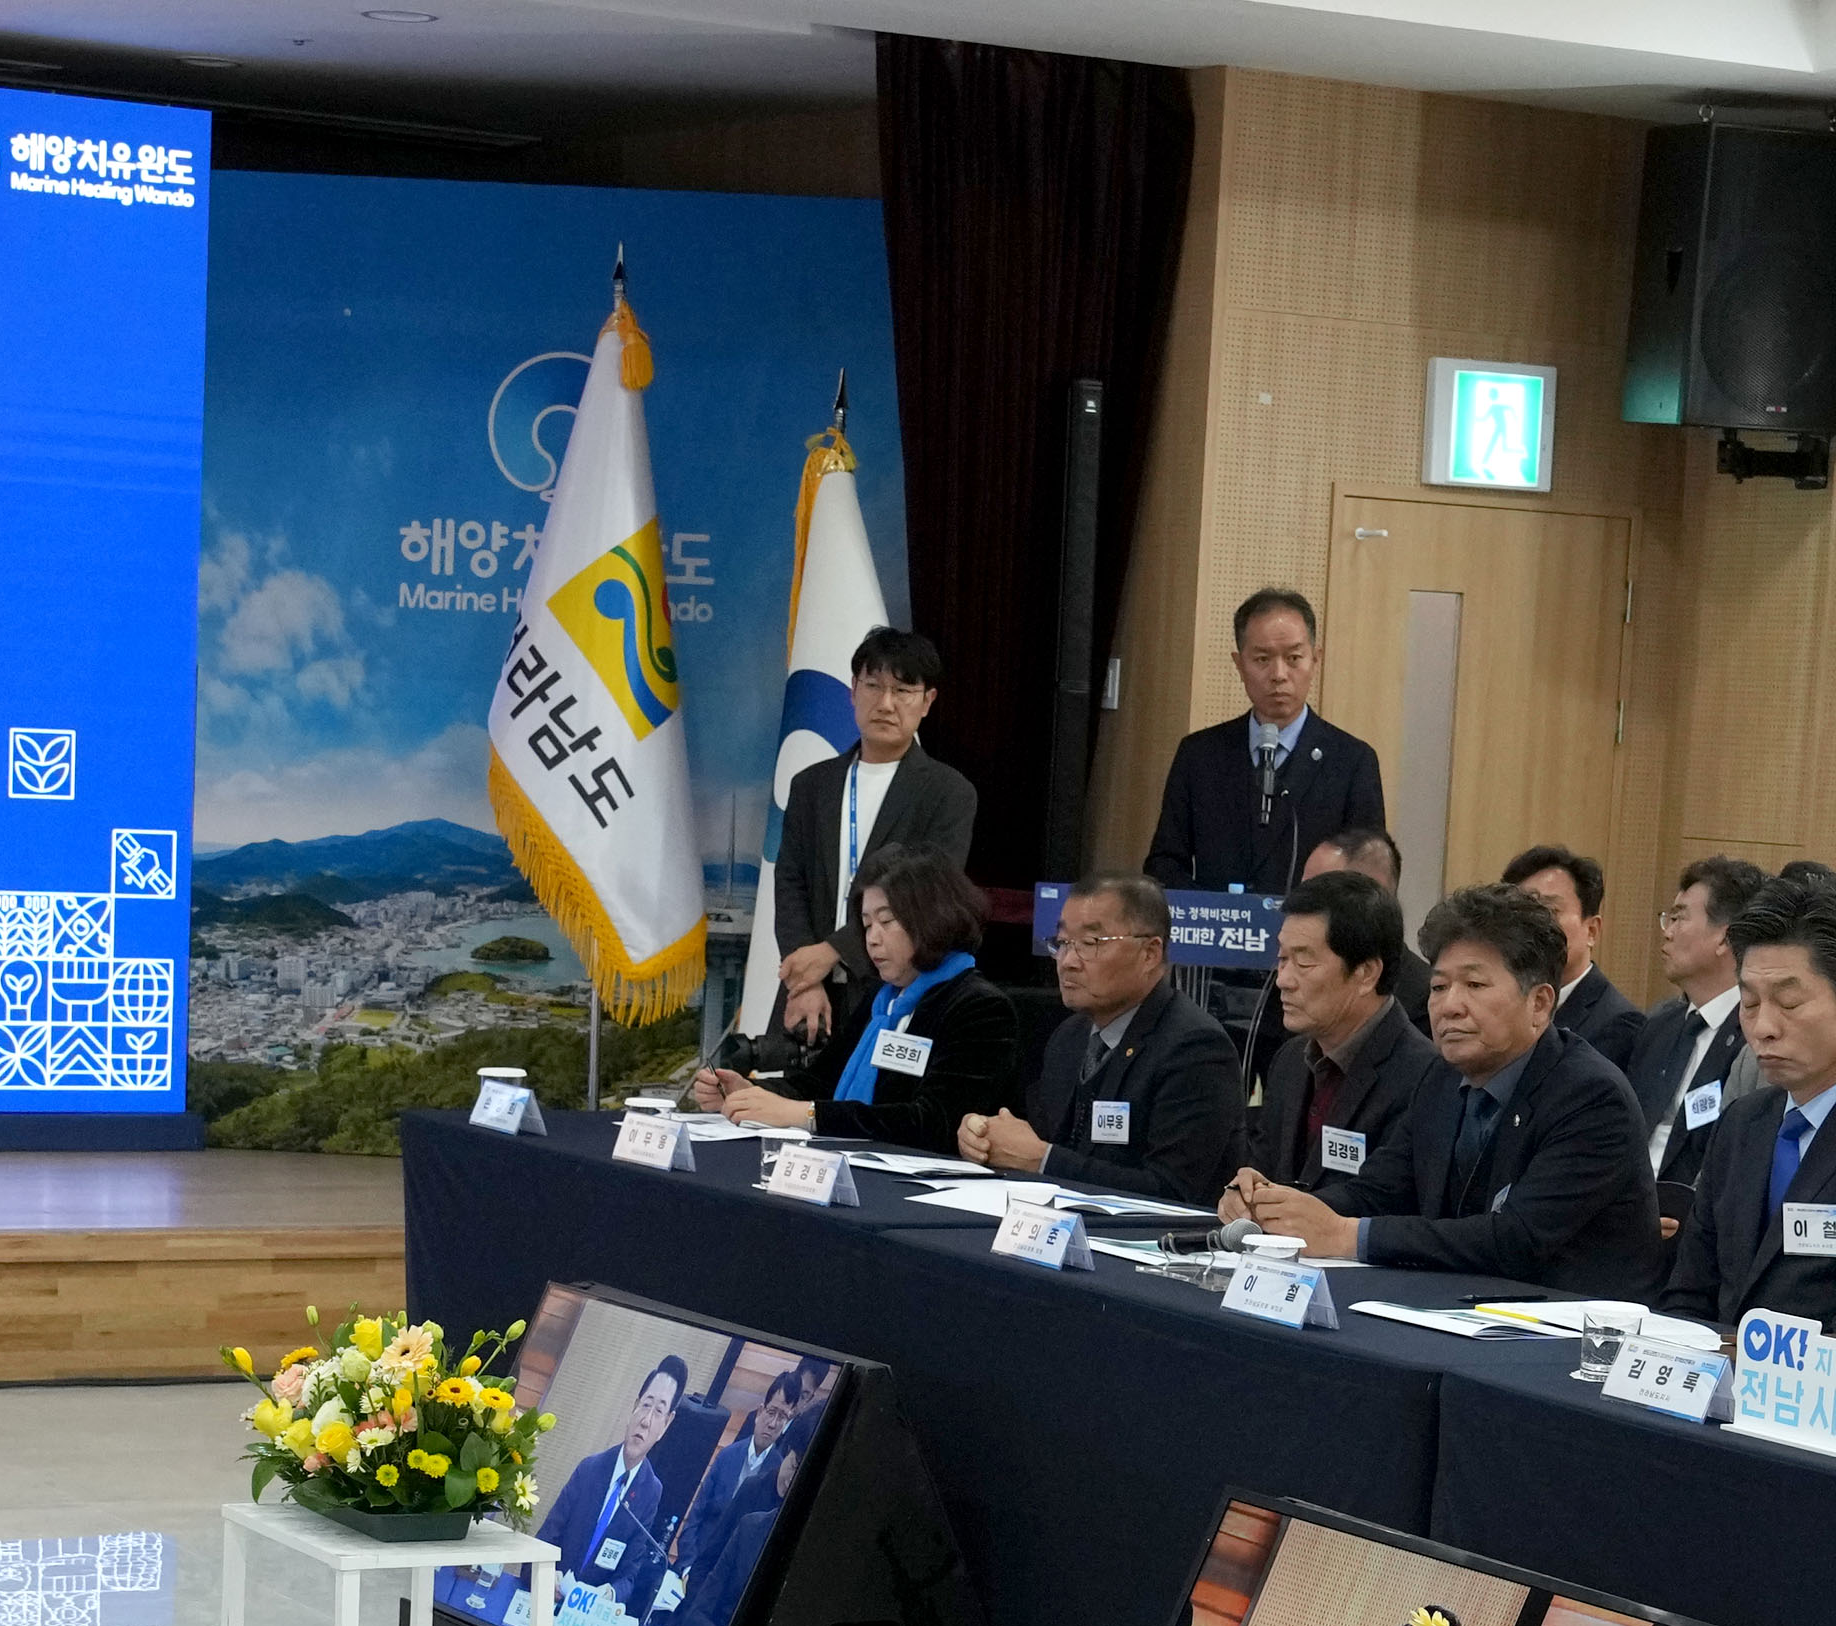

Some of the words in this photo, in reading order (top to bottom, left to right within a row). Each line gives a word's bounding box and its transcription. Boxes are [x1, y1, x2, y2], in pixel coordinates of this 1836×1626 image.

[10, 132, 195, 185] 해양치유완도
[10, 171, 70, 195] Marine
[71, 178, 133, 206] Healing
[134, 184, 195, 207] Wando
[398, 582, 497, 614] Marine
[506, 609, 635, 829] 라남도
[1188, 906, 1251, 923] 정책비전투어
[1170, 926, 1215, 946] 위대한
[1218, 927, 1269, 952] 전남
[882, 1043, 922, 1063] 손정희
[1097, 1114, 1124, 1130] 이무웅
[1328, 1140, 1359, 1162] 김경열
[1743, 1318, 1809, 1372] OK!
